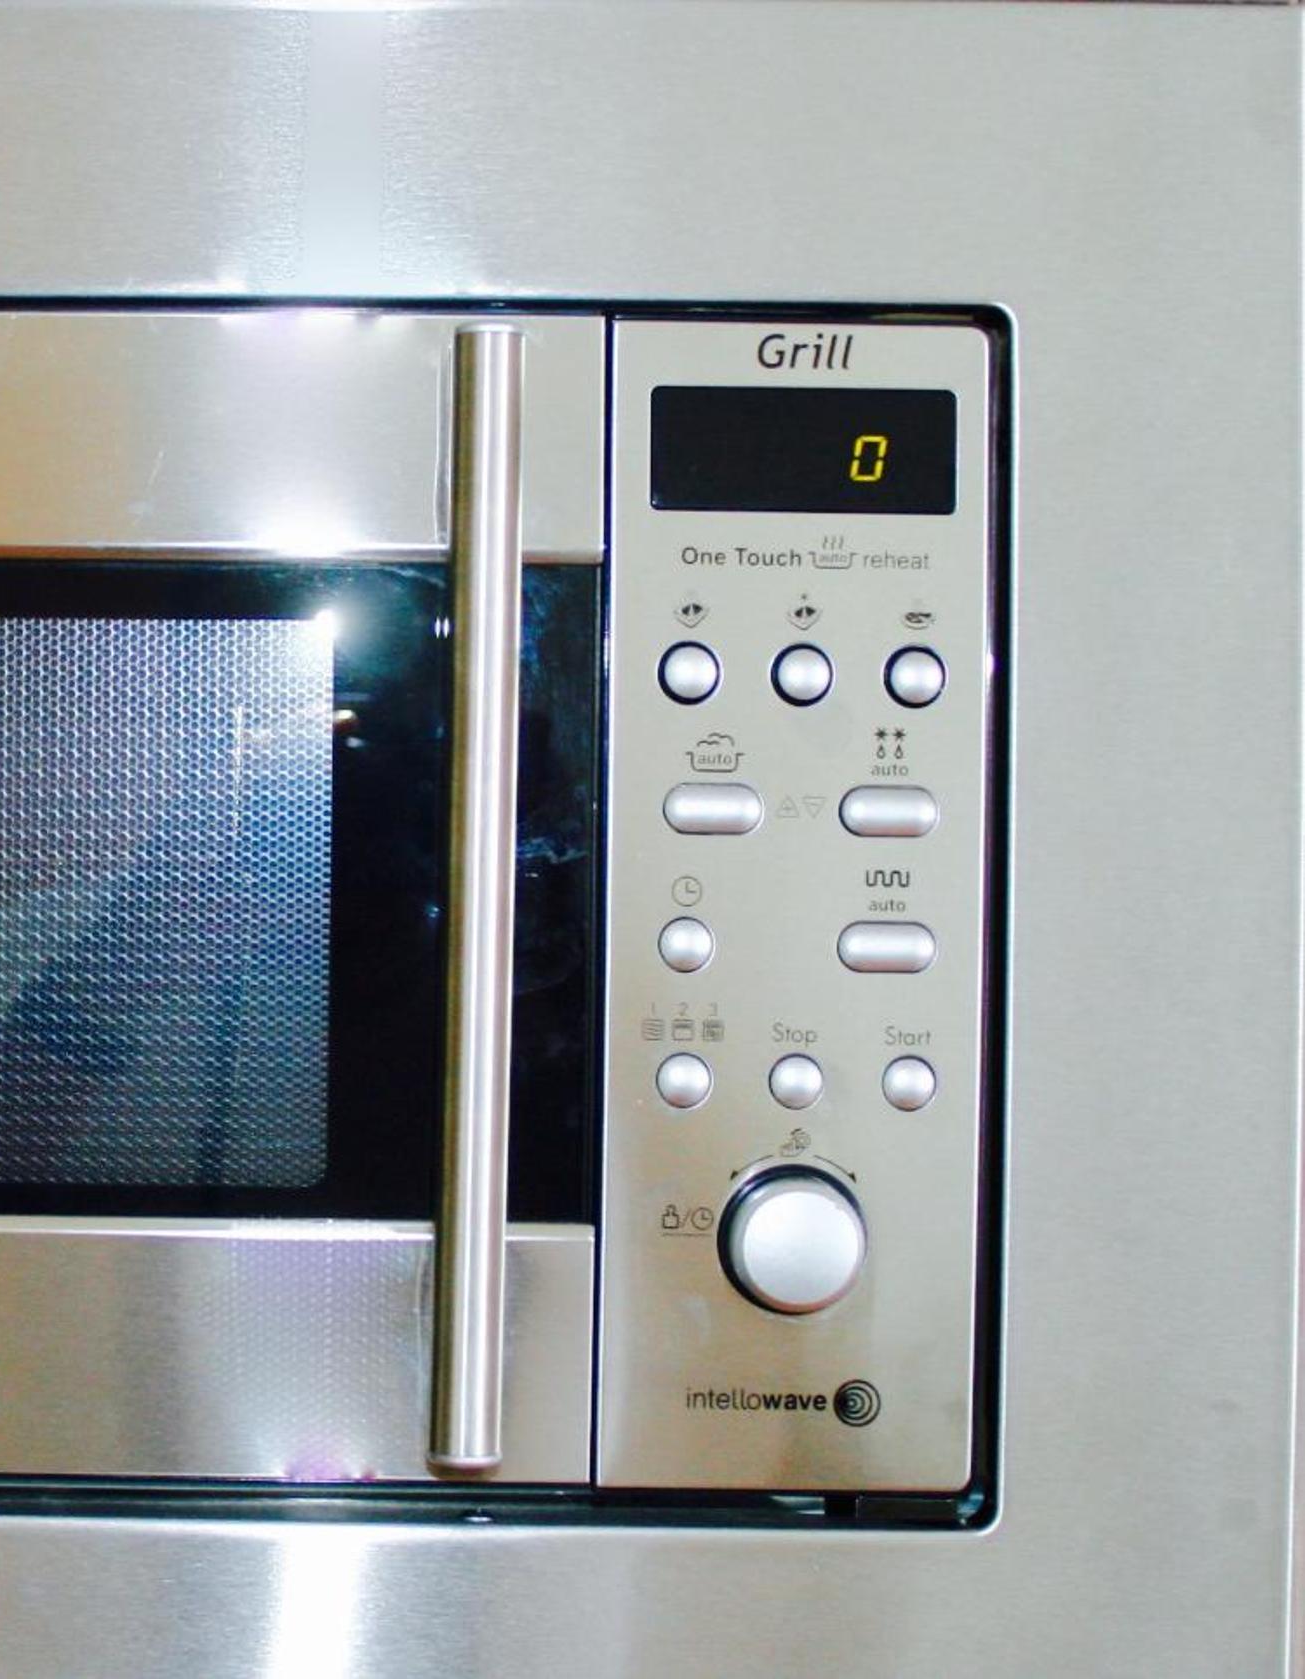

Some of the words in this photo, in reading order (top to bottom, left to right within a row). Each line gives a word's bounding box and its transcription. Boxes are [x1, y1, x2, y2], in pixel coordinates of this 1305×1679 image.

[756, 333, 855, 370] Grill
[849, 434, 889, 482] 0
[681, 547, 727, 567] One
[735, 548, 802, 568] Touch
[862, 550, 930, 570] reheat
[697, 752, 733, 766] auto
[870, 763, 909, 778] auto
[868, 899, 907, 913] auto
[771, 1023, 818, 1047] Stop
[883, 1026, 932, 1047] Start
[685, 1387, 828, 1411] intellowave
